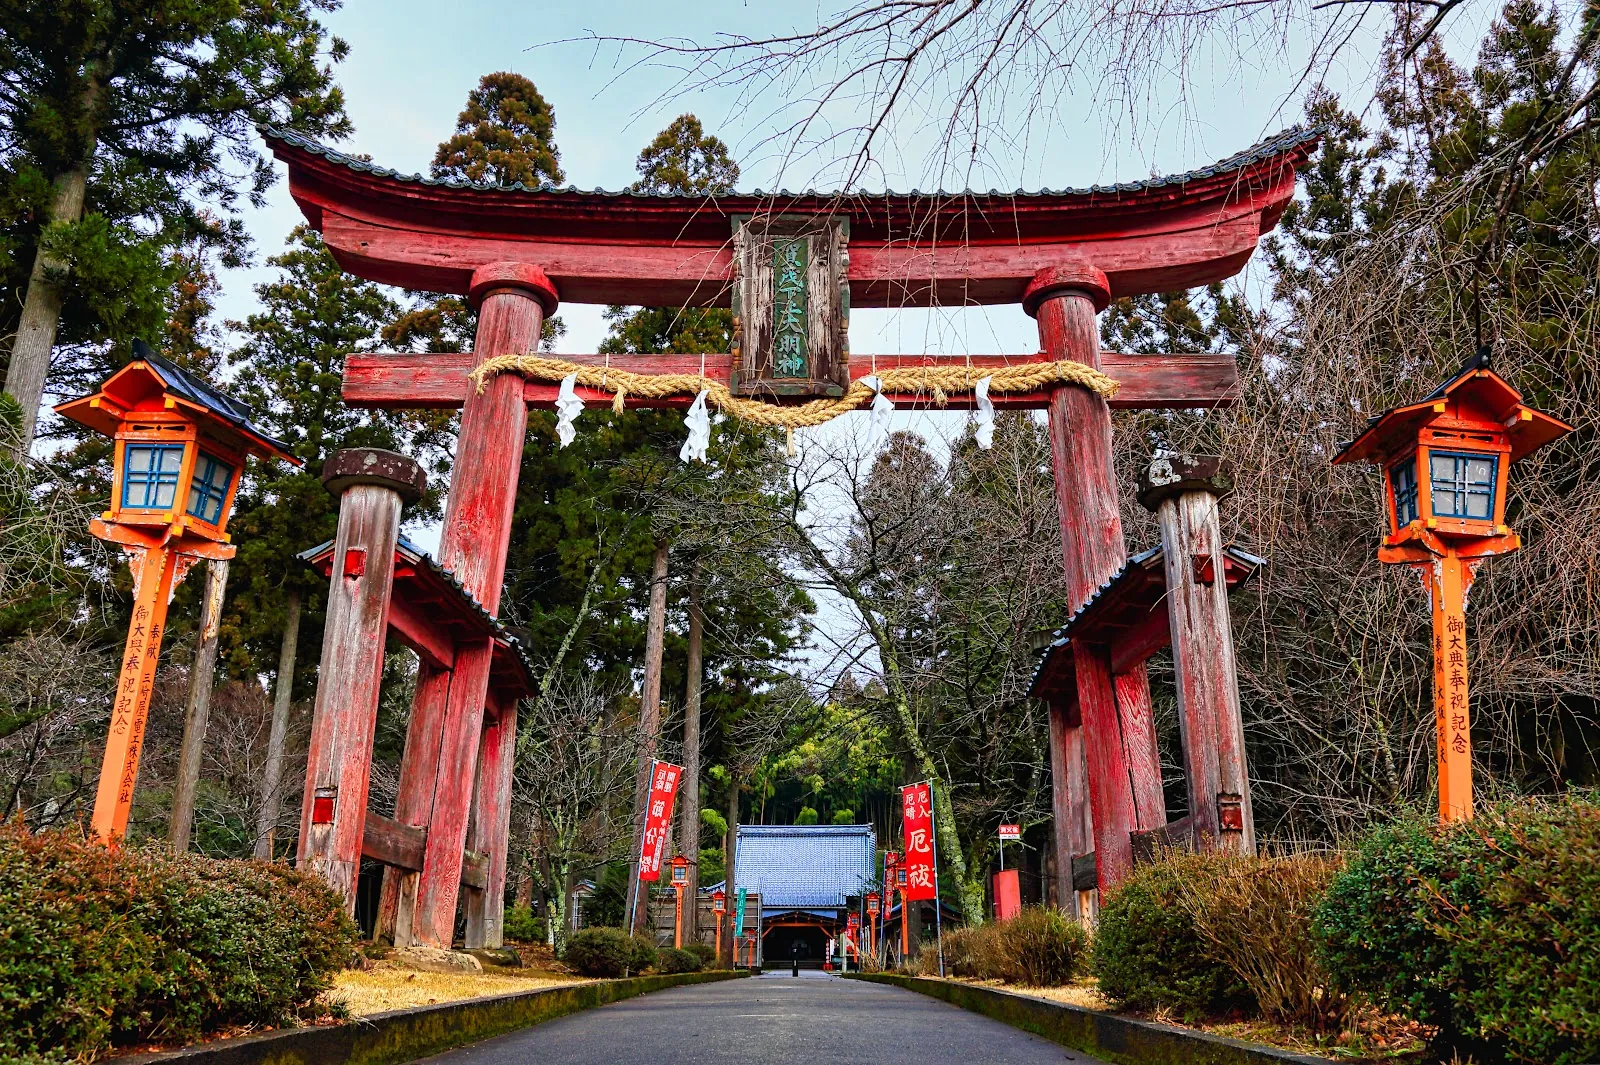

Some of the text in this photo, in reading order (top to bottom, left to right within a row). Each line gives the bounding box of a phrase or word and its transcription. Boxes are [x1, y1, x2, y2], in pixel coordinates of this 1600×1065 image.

[1446, 615, 1468, 754] 御大典奉祝記念
[905, 793, 916, 820] 厄晴
[917, 790, 930, 818] 厄入
[908, 828, 934, 889] 厄祓
